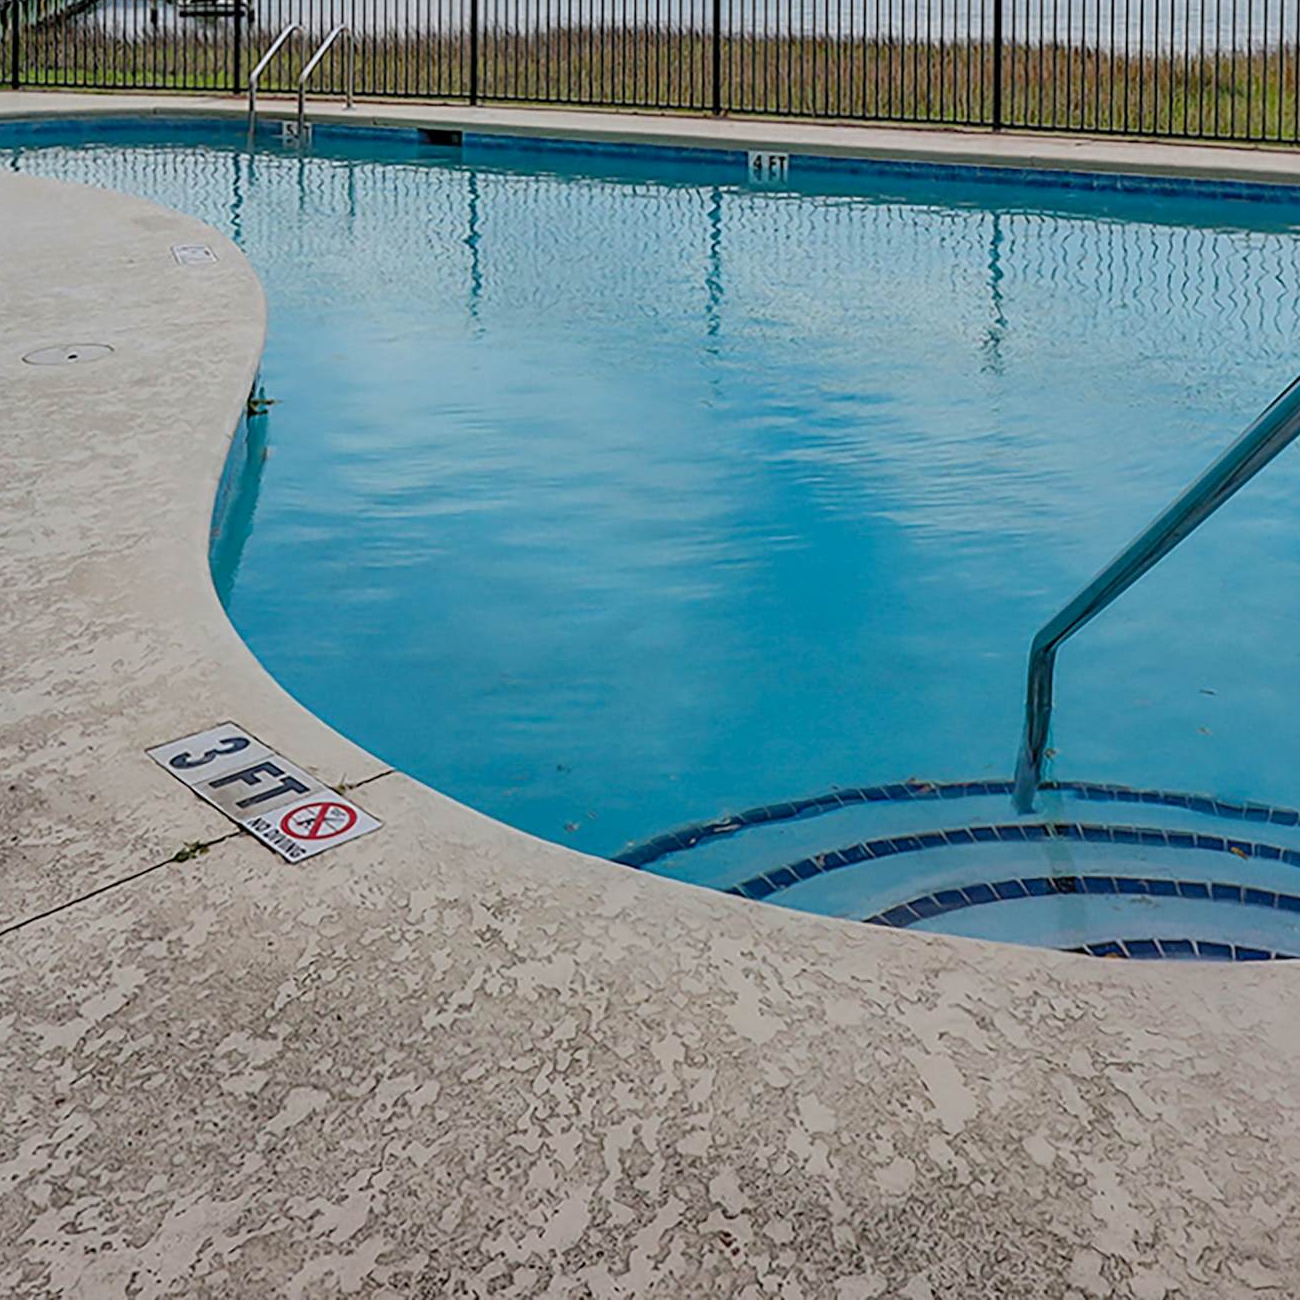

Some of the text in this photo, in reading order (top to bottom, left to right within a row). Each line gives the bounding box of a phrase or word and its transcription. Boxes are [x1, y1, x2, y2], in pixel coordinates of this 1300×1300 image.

[753, 154, 786, 171] 4 FT
[169, 736, 311, 809] 3 FT
